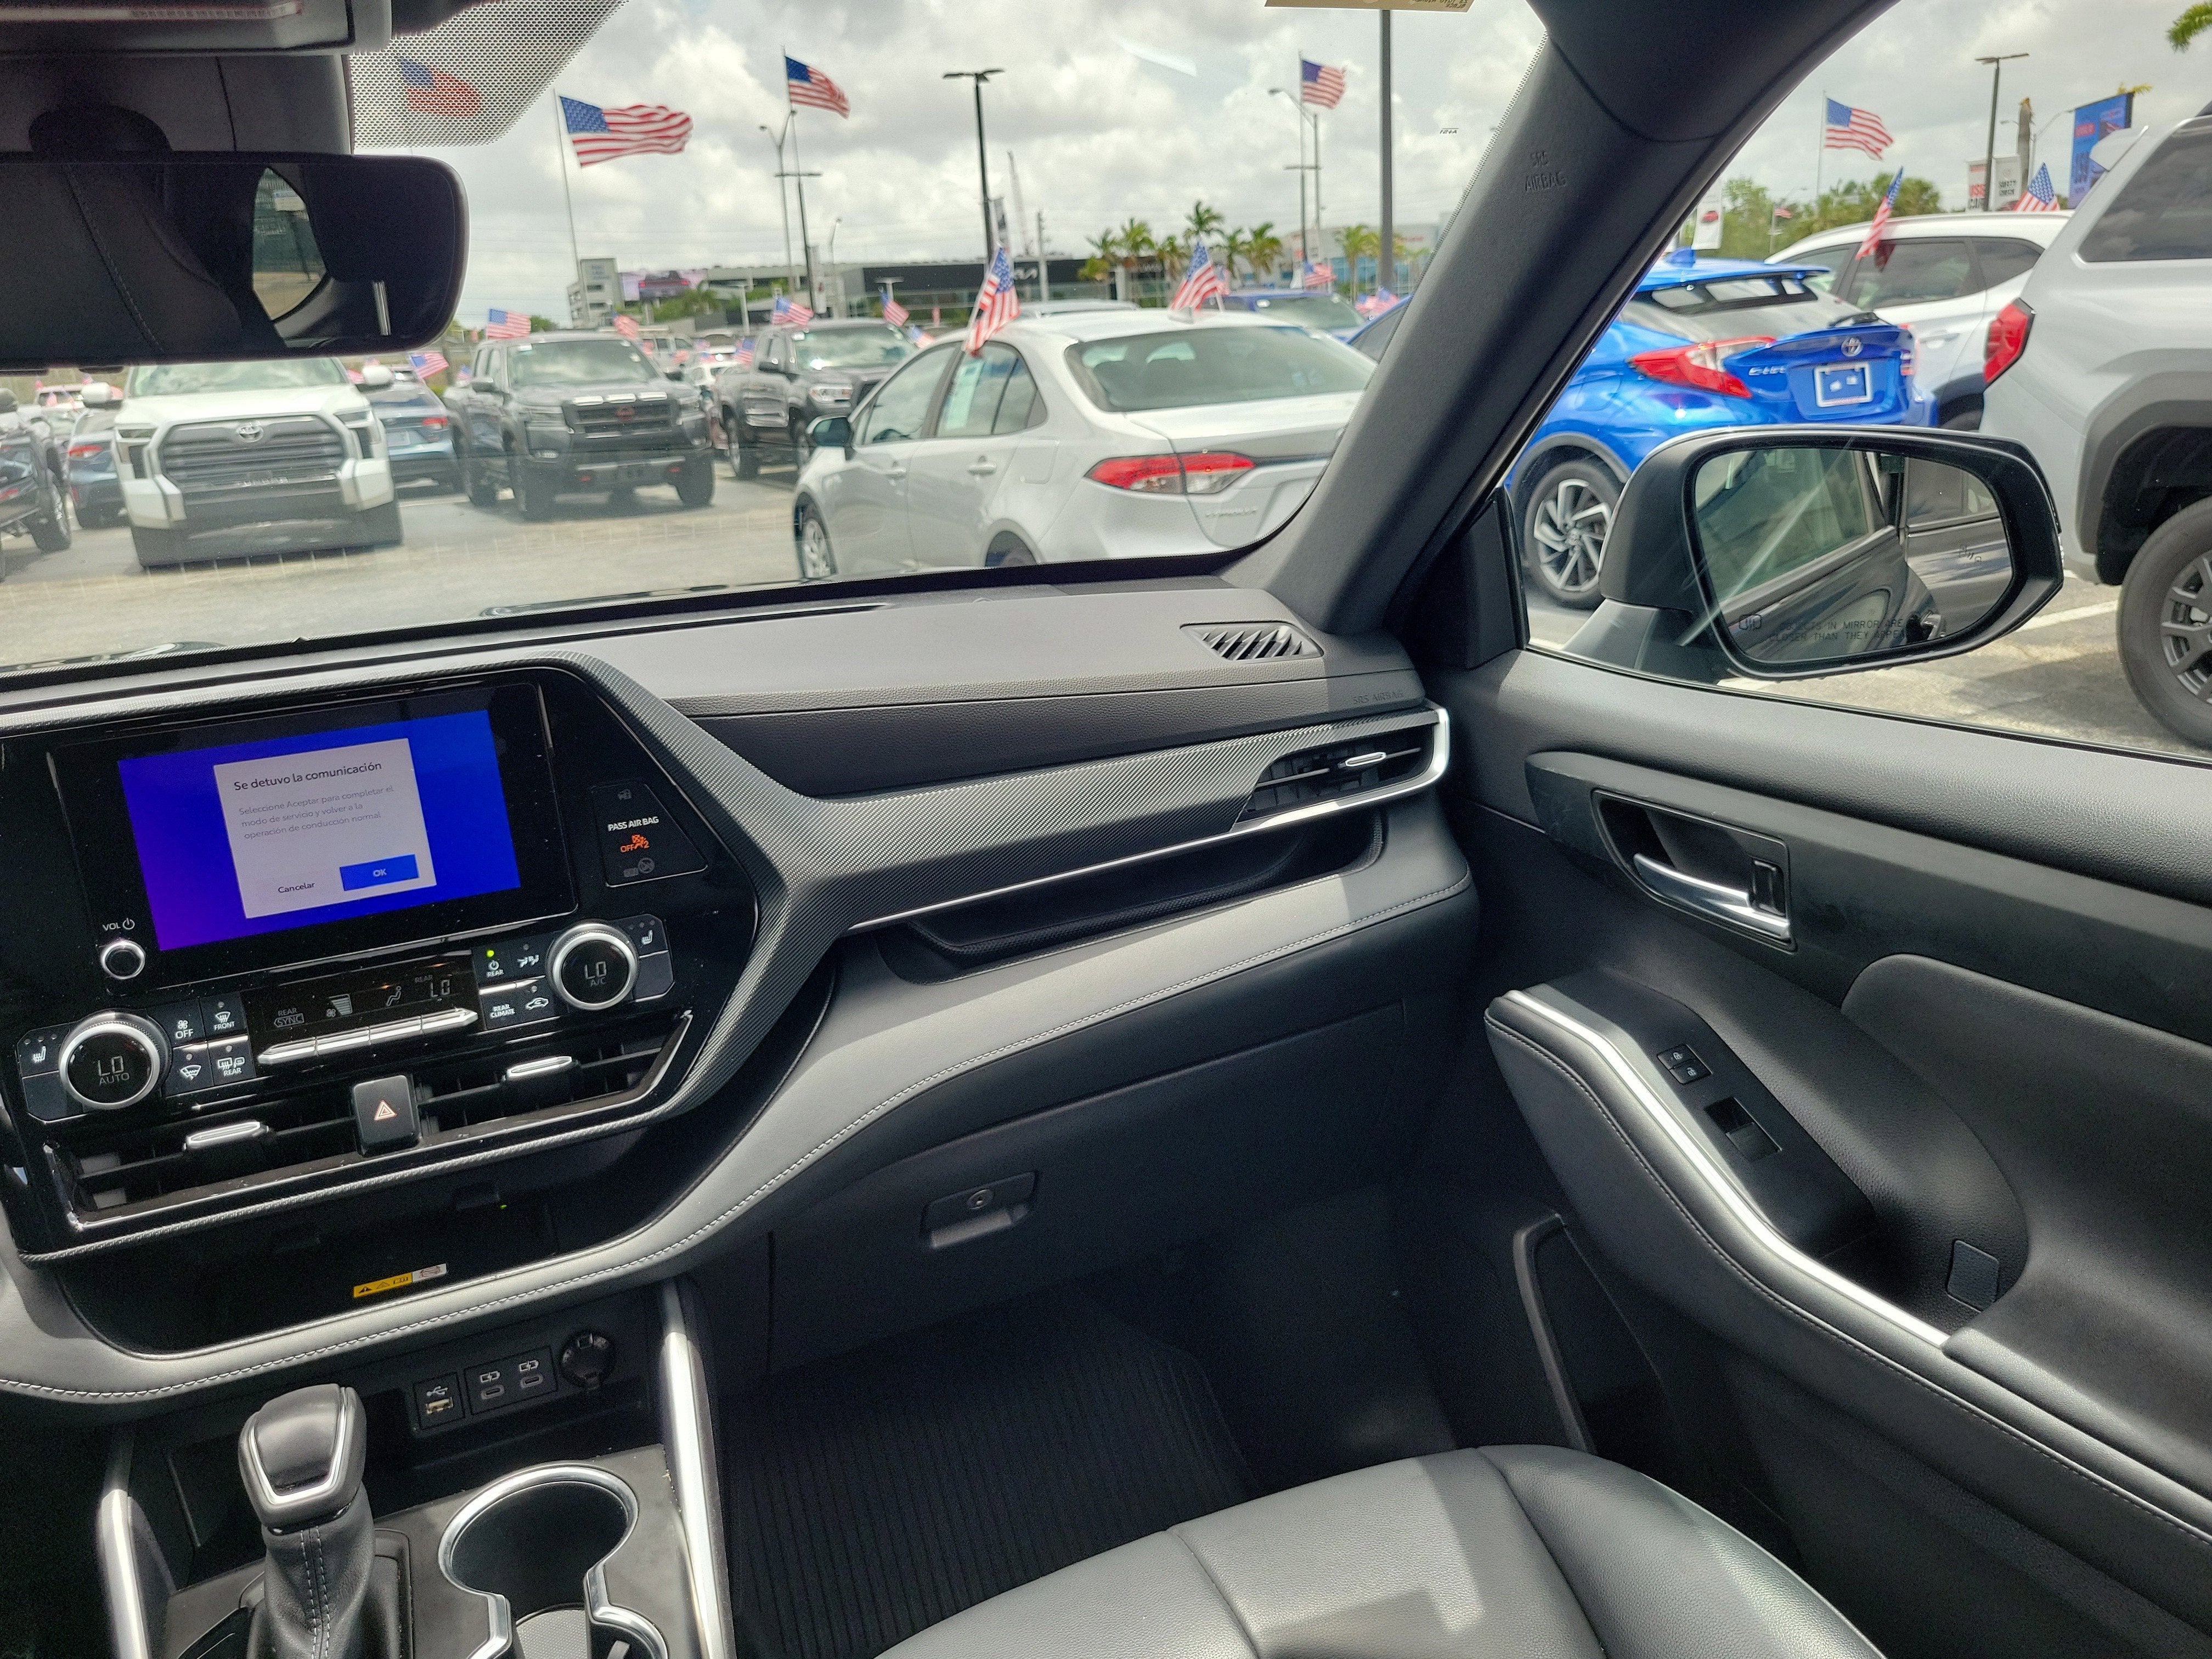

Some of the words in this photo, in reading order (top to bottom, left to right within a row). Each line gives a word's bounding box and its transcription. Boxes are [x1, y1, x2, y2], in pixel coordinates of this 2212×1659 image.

[1525, 171, 1566, 192] AIRBAG
[1843, 620, 1879, 629] MIRROR
[1815, 632, 1838, 641] THAN
[1846, 631, 1868, 640] THEY
[234, 781, 249, 791] Se
[251, 776, 291, 788] detuvo
[292, 773, 303, 782] la
[305, 762, 382, 781] comunicación
[239, 803, 285, 815] Seleccione
[287, 797, 319, 809] Aceptar
[321, 795, 340, 805] para
[341, 787, 383, 800] completar
[386, 785, 394, 793] el
[241, 817, 268, 827] modo
[282, 810, 314, 821] servicio
[315, 810, 320, 818] y
[321, 805, 346, 815] volver
[355, 802, 363, 810] la
[244, 827, 287, 840] operación
[289, 823, 300, 832] de
[302, 816, 350, 830] conducción
[352, 811, 382, 823] normal
[607, 822, 628, 832] PASS
[628, 818, 643, 828] AIR
[643, 816, 659, 826] BAG
[620, 843, 635, 853] OFF
[373, 868, 387, 878] OK
[278, 882, 315, 893] Cancelar
[102, 922, 121, 932] VOL
[486, 969, 504, 978] REAR
[414, 974, 433, 984] REAR
[589, 977, 606, 987] A/C
[278, 1007, 298, 1017] REAR
[493, 1003, 511, 1012] REAR
[489, 1008, 516, 1019] CLIMATE
[277, 1015, 301, 1026] SYNC
[214, 1021, 235, 1031] FRONT
[174, 1028, 194, 1039] OFF
[223, 1066, 242, 1076] REAR
[99, 1072, 130, 1085] AUTO
